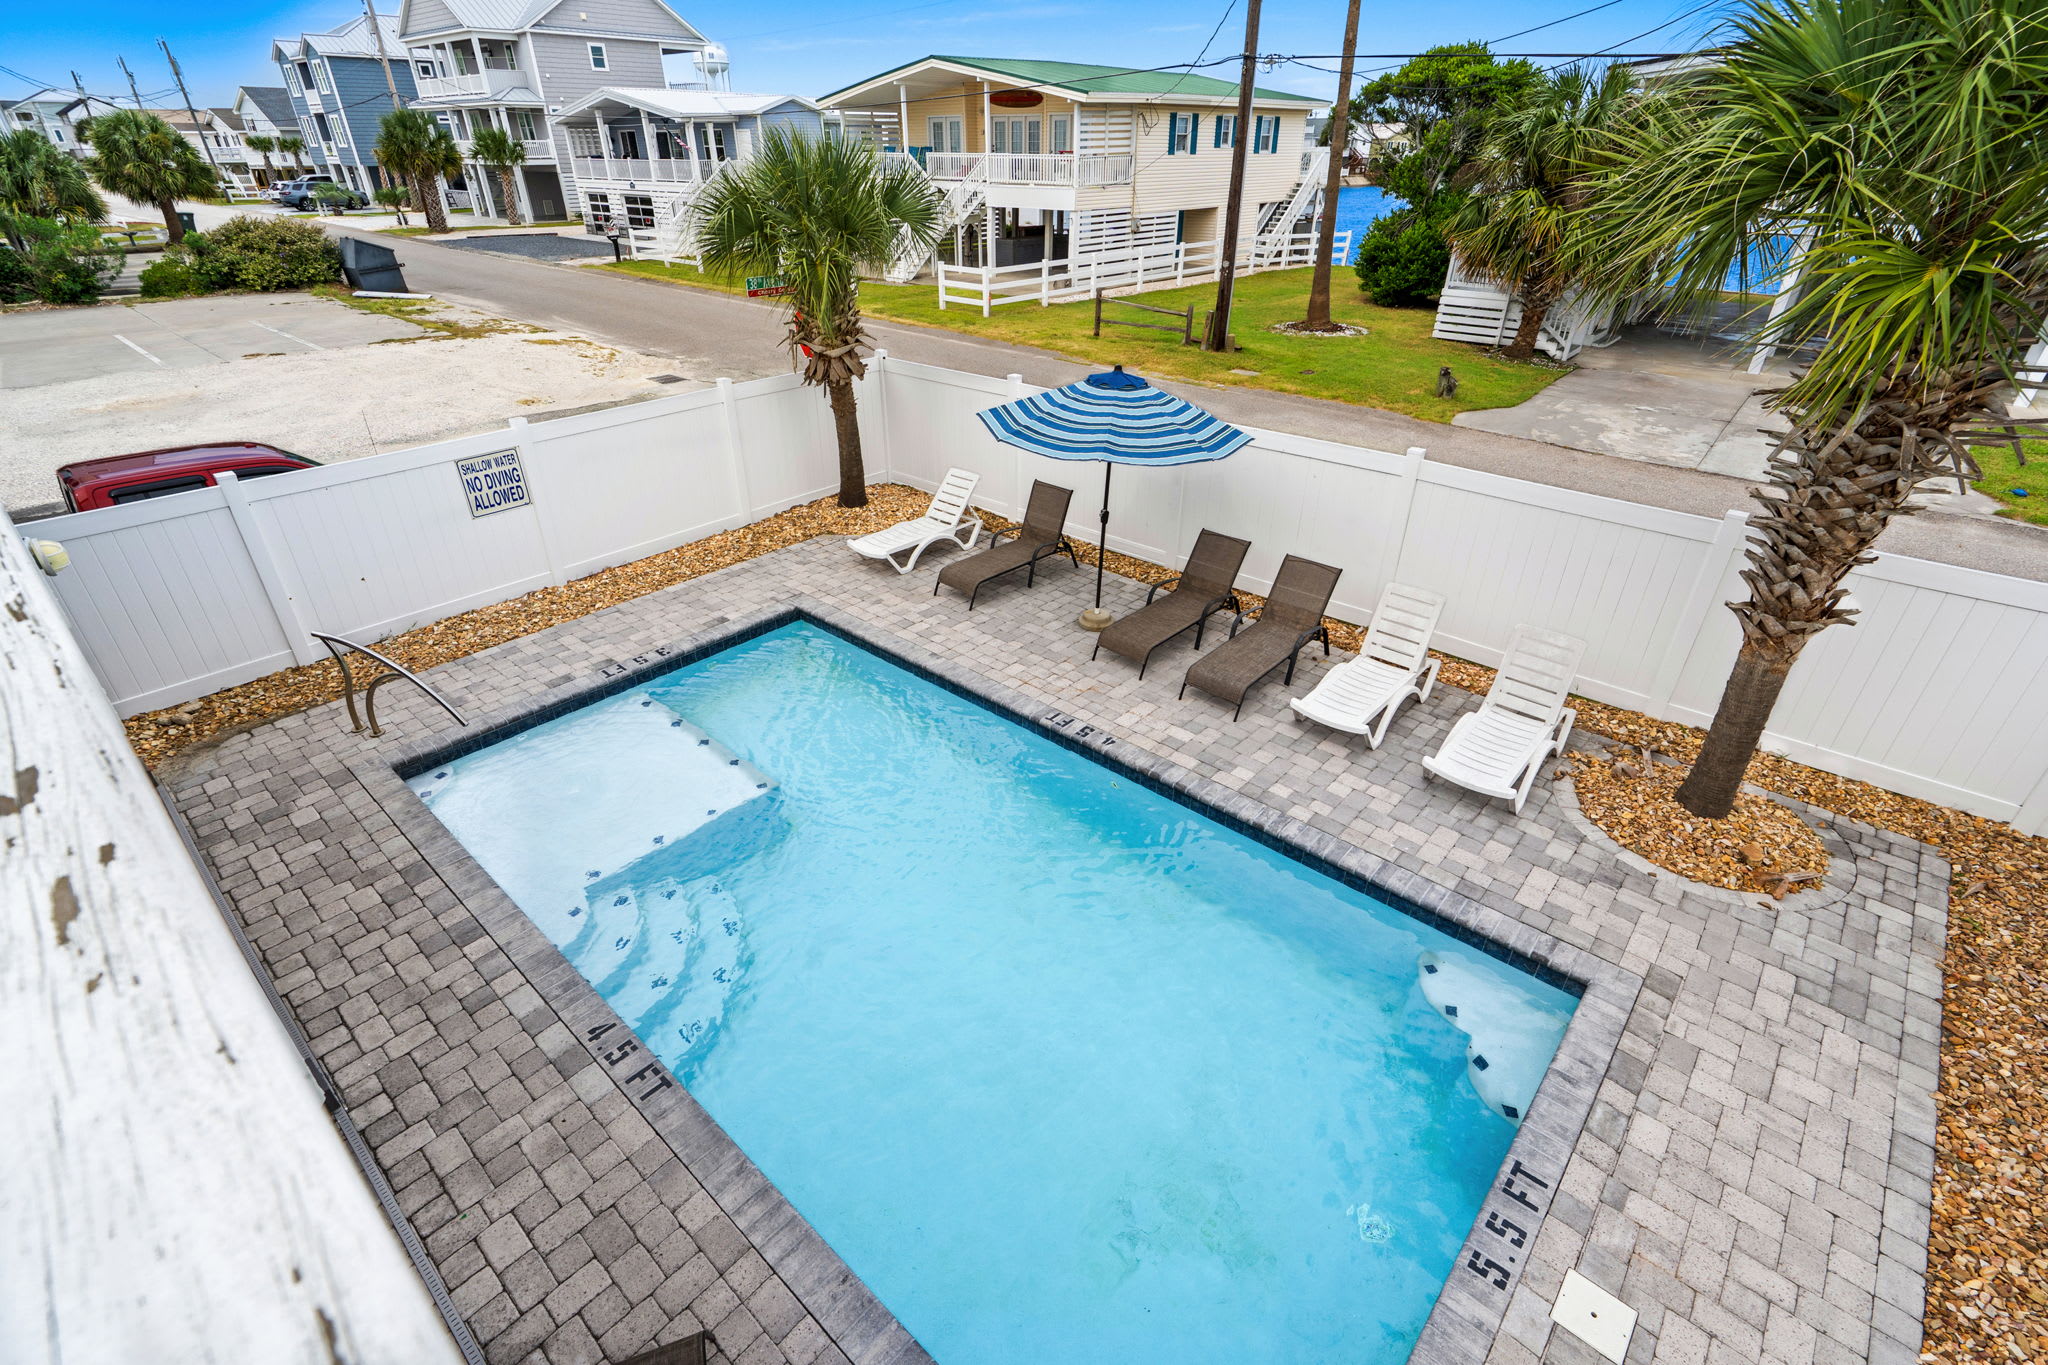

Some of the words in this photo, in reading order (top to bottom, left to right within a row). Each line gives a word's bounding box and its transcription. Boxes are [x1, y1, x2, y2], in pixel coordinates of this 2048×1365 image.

[461, 460, 492, 476] SHALLOW
[493, 453, 516, 468] WATER
[466, 476, 483, 495] NO
[484, 467, 521, 490] DIVING
[474, 485, 525, 512] ALLOWED
[600, 663, 627, 679] FT
[1045, 712, 1075, 728] FT
[1075, 725, 1116, 746] 4.5
[587, 1022, 639, 1067] 4.5
[624, 1062, 673, 1101] FT
[1467, 1211, 1528, 1292] 5.5
[1501, 1159, 1549, 1213] FT
